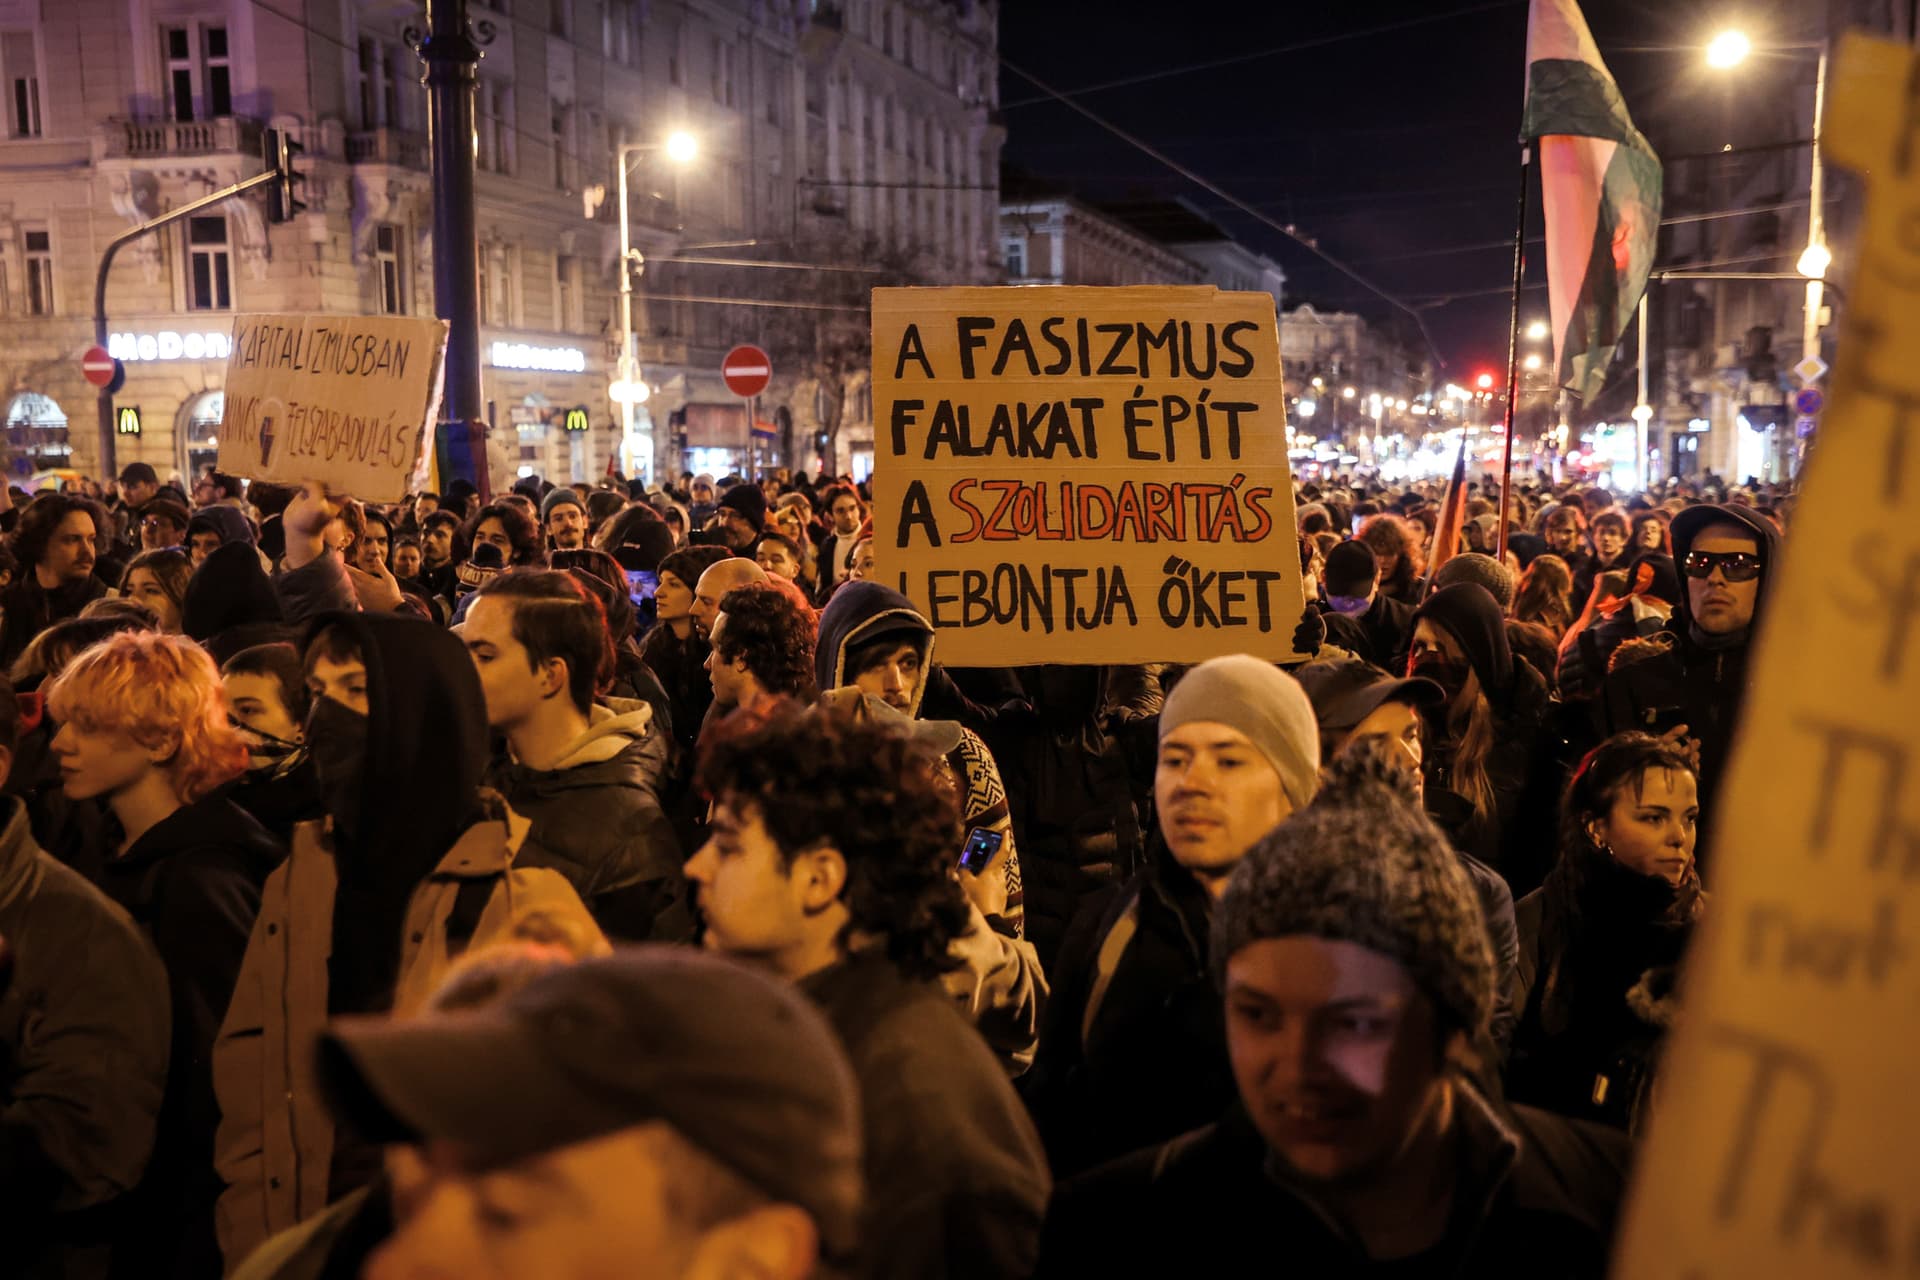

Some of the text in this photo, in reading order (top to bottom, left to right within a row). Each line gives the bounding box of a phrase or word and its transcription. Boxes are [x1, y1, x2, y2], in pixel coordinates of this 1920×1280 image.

[233, 325, 410, 379] KAPITALIZMUSBAN
[895, 316, 1259, 380] A FASIZMUS
[222, 396, 410, 468] NINCS FELSZABADULÁS
[891, 385, 1259, 463] FALAKAT ÉPÍT
[896, 473, 1273, 548] A SZOLIDARITÁS
[1157, 555, 1281, 633] ŐKET
